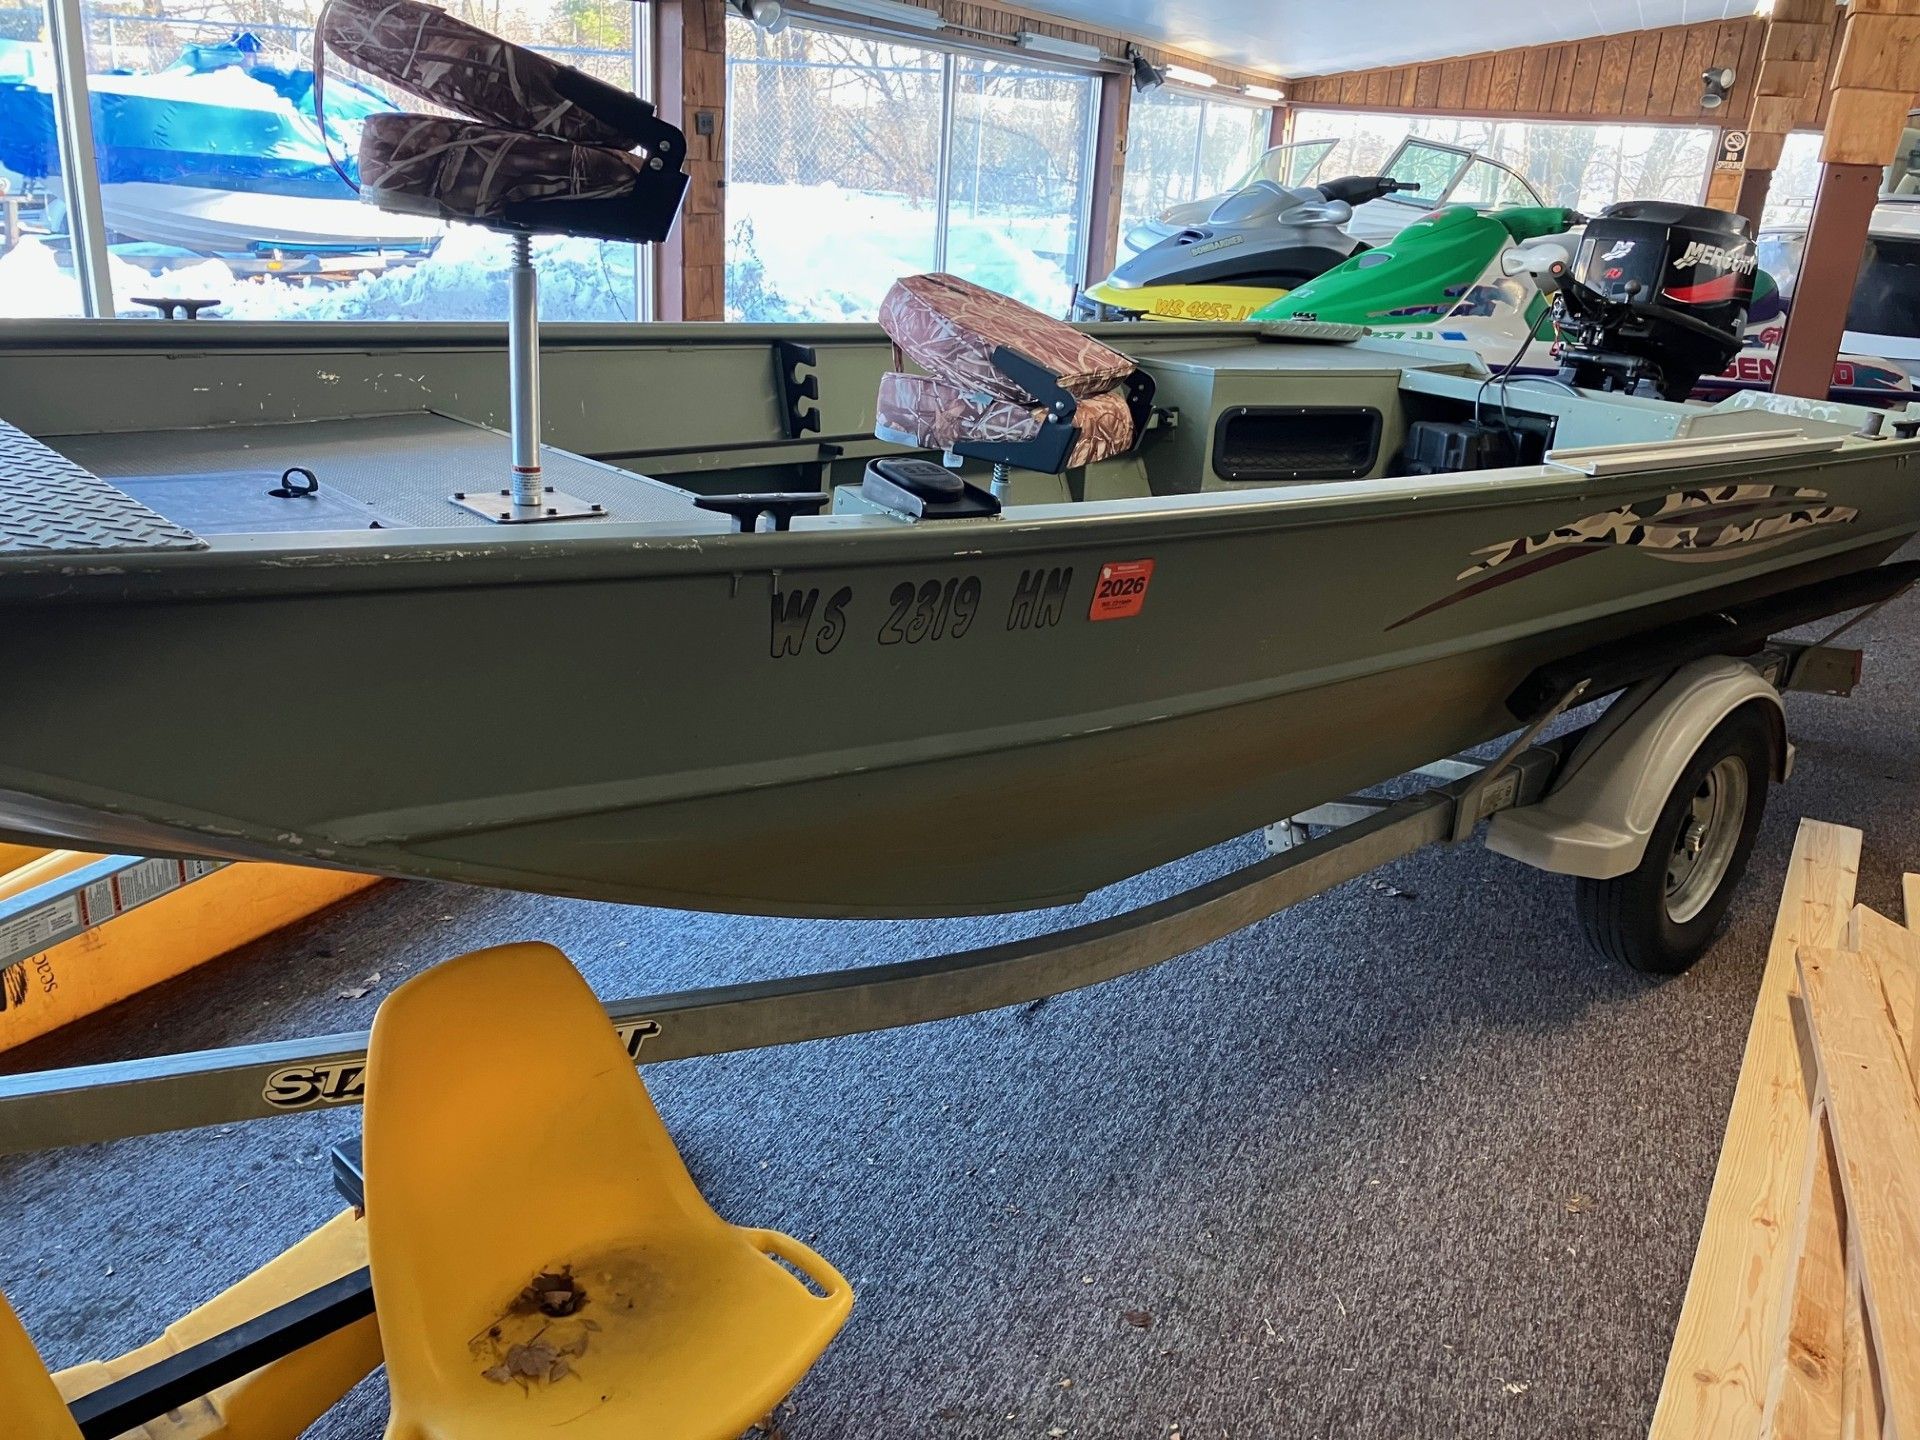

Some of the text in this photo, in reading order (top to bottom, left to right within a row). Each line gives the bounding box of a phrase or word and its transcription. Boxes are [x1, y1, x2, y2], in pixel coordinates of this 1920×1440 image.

[1726, 152, 1737, 161] NO
[1673, 241, 1755, 276] MERCURY
[1155, 299, 1184, 316] WS
[1186, 301, 1231, 321] 4255
[1097, 576, 1146, 599] 2026
[770, 567, 1073, 658] WS 2319 HN
